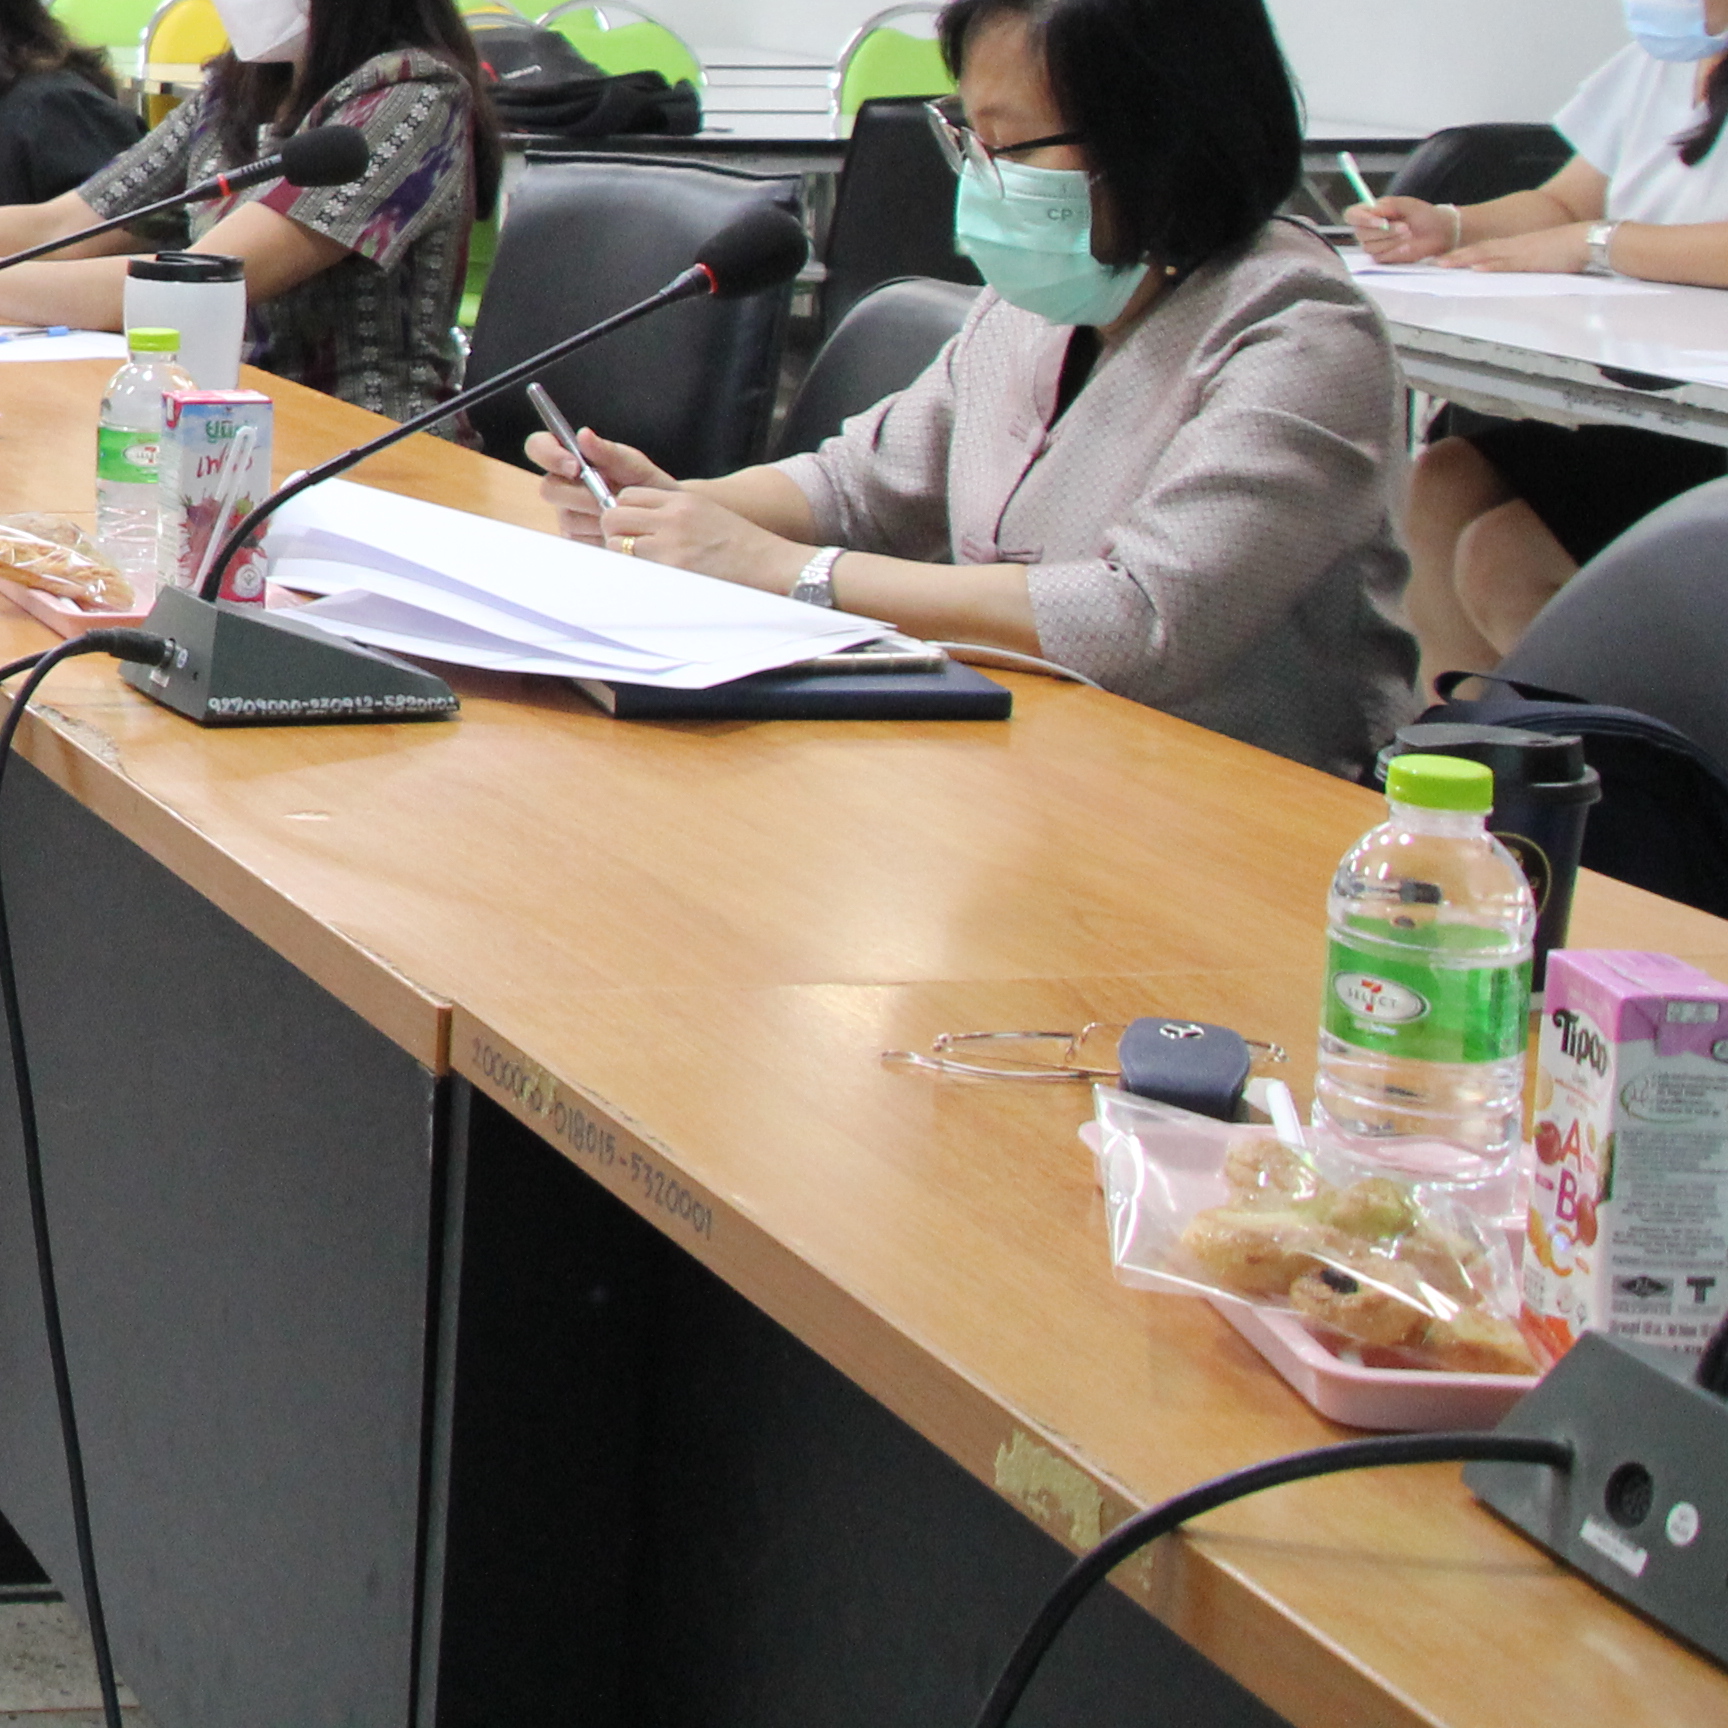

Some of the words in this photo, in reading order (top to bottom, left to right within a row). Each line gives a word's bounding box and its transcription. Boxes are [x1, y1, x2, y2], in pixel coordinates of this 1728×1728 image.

[1347, 987, 1398, 1009] SELECT
[1559, 1118, 1582, 1173] A
[1555, 1168, 1578, 1222] B
